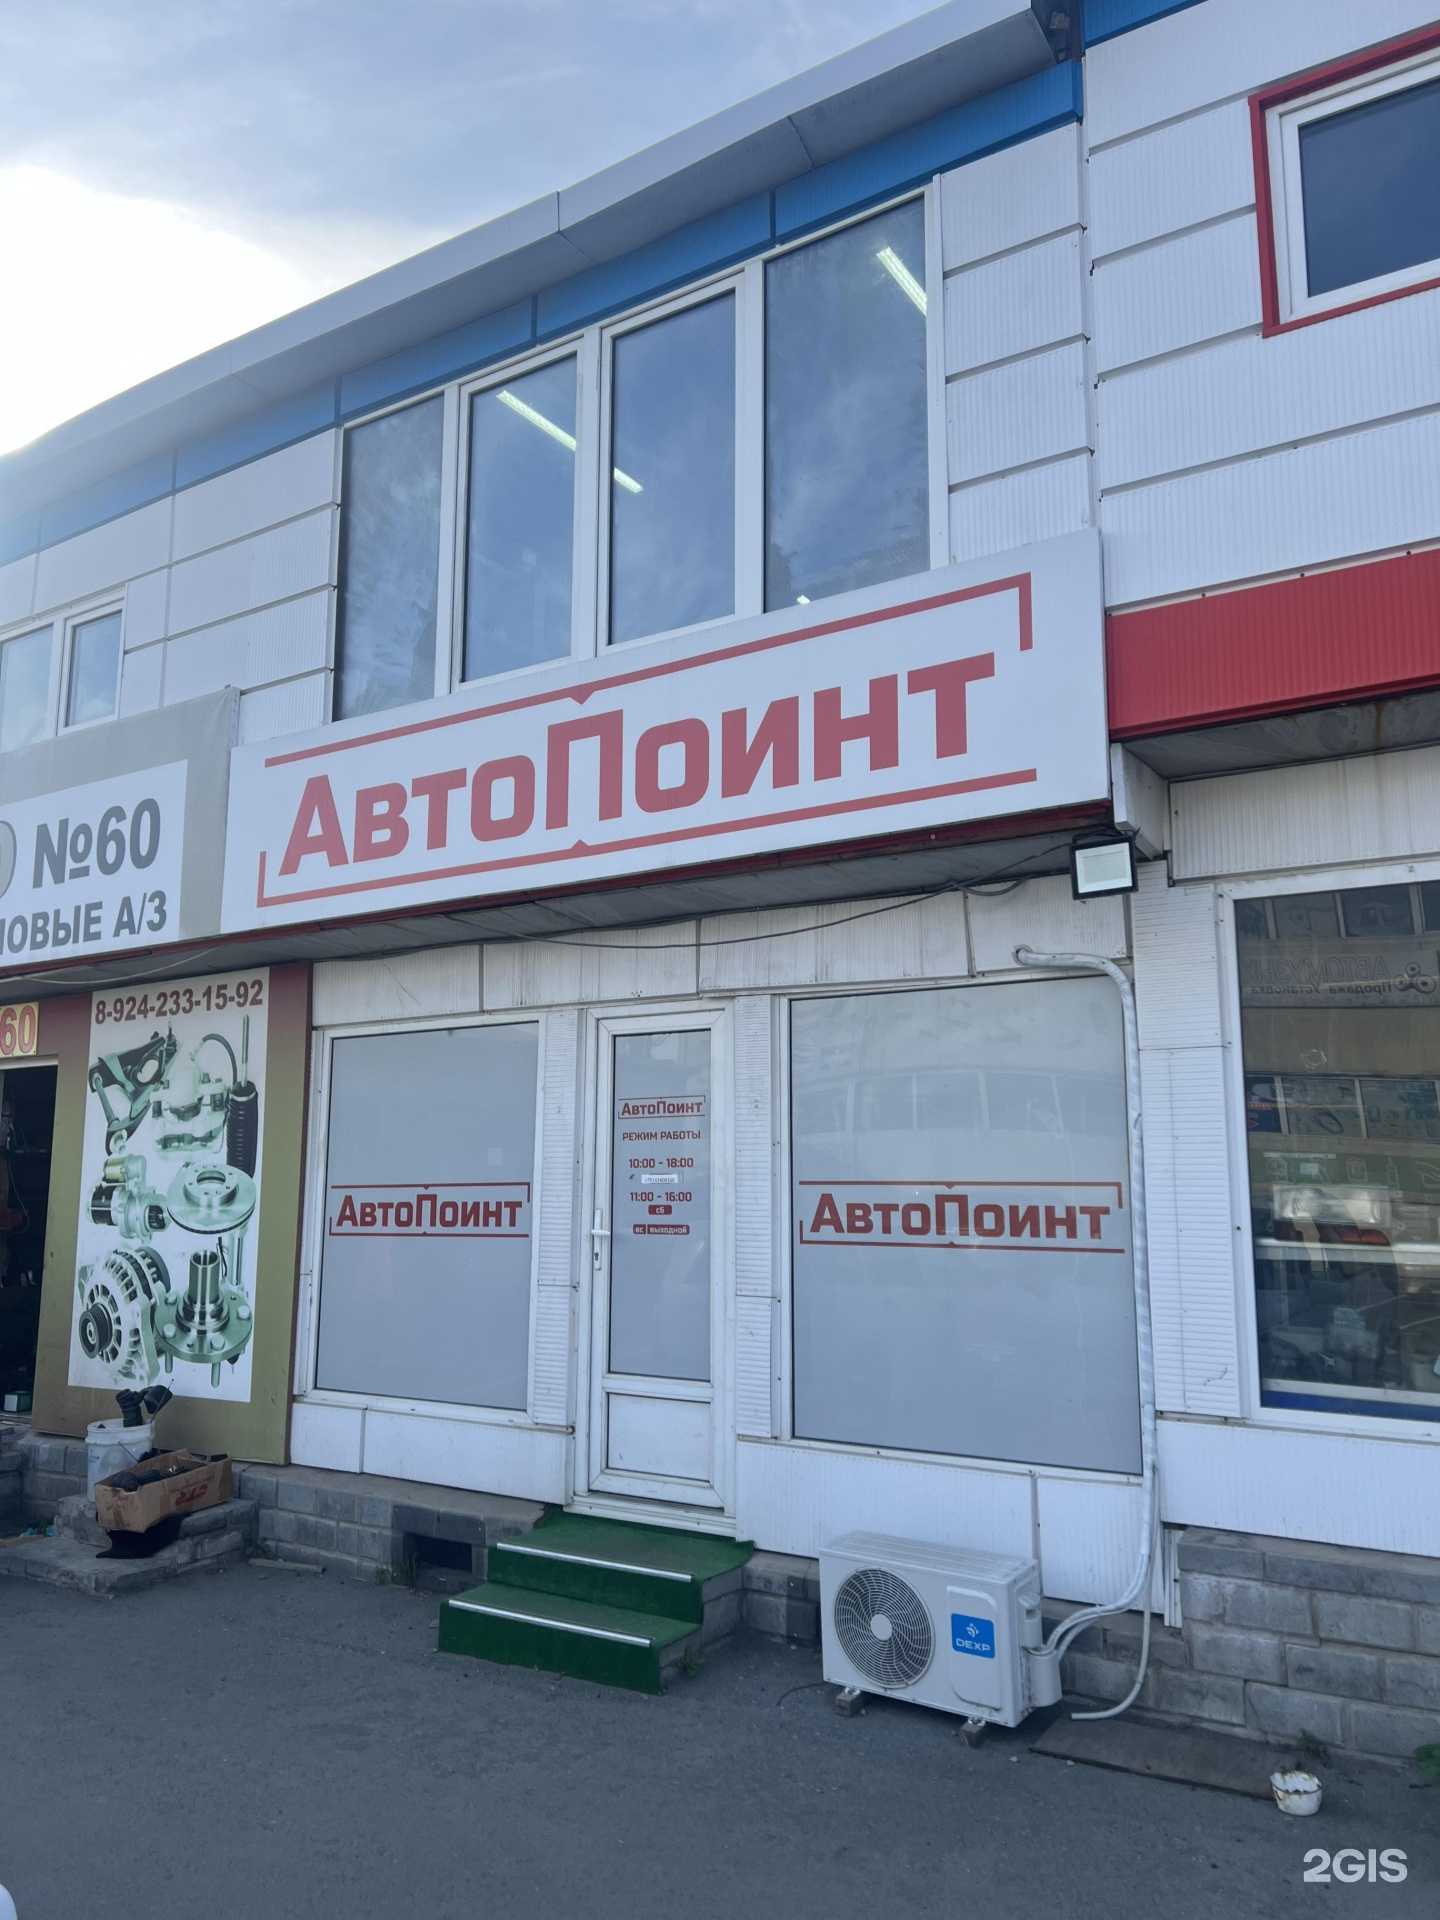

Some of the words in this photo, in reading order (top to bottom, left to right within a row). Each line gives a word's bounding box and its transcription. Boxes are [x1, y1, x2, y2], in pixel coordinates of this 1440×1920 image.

[278, 651, 996, 876] АвтоПоинт
[32, 798, 161, 889] №60
[0, 902, 103, 955] ОВЫЕ
[95, 978, 264, 1025] 8-924-233-15-92
[622, 1100, 703, 1116] АвтоПоинт
[622, 1131, 658, 1141] РЕЖИМ
[660, 1130, 701, 1140] РАБОТЫ
[629, 1158, 656, 1168] 10:00
[666, 1158, 694, 1168] 18:00
[336, 1194, 523, 1227] АвтоПоинт
[630, 1192, 654, 1201] 11:00
[665, 1192, 692, 1202] 16:00
[810, 1193, 1111, 1239] АвтоПоинт
[956, 1638, 991, 1651] DEXP
